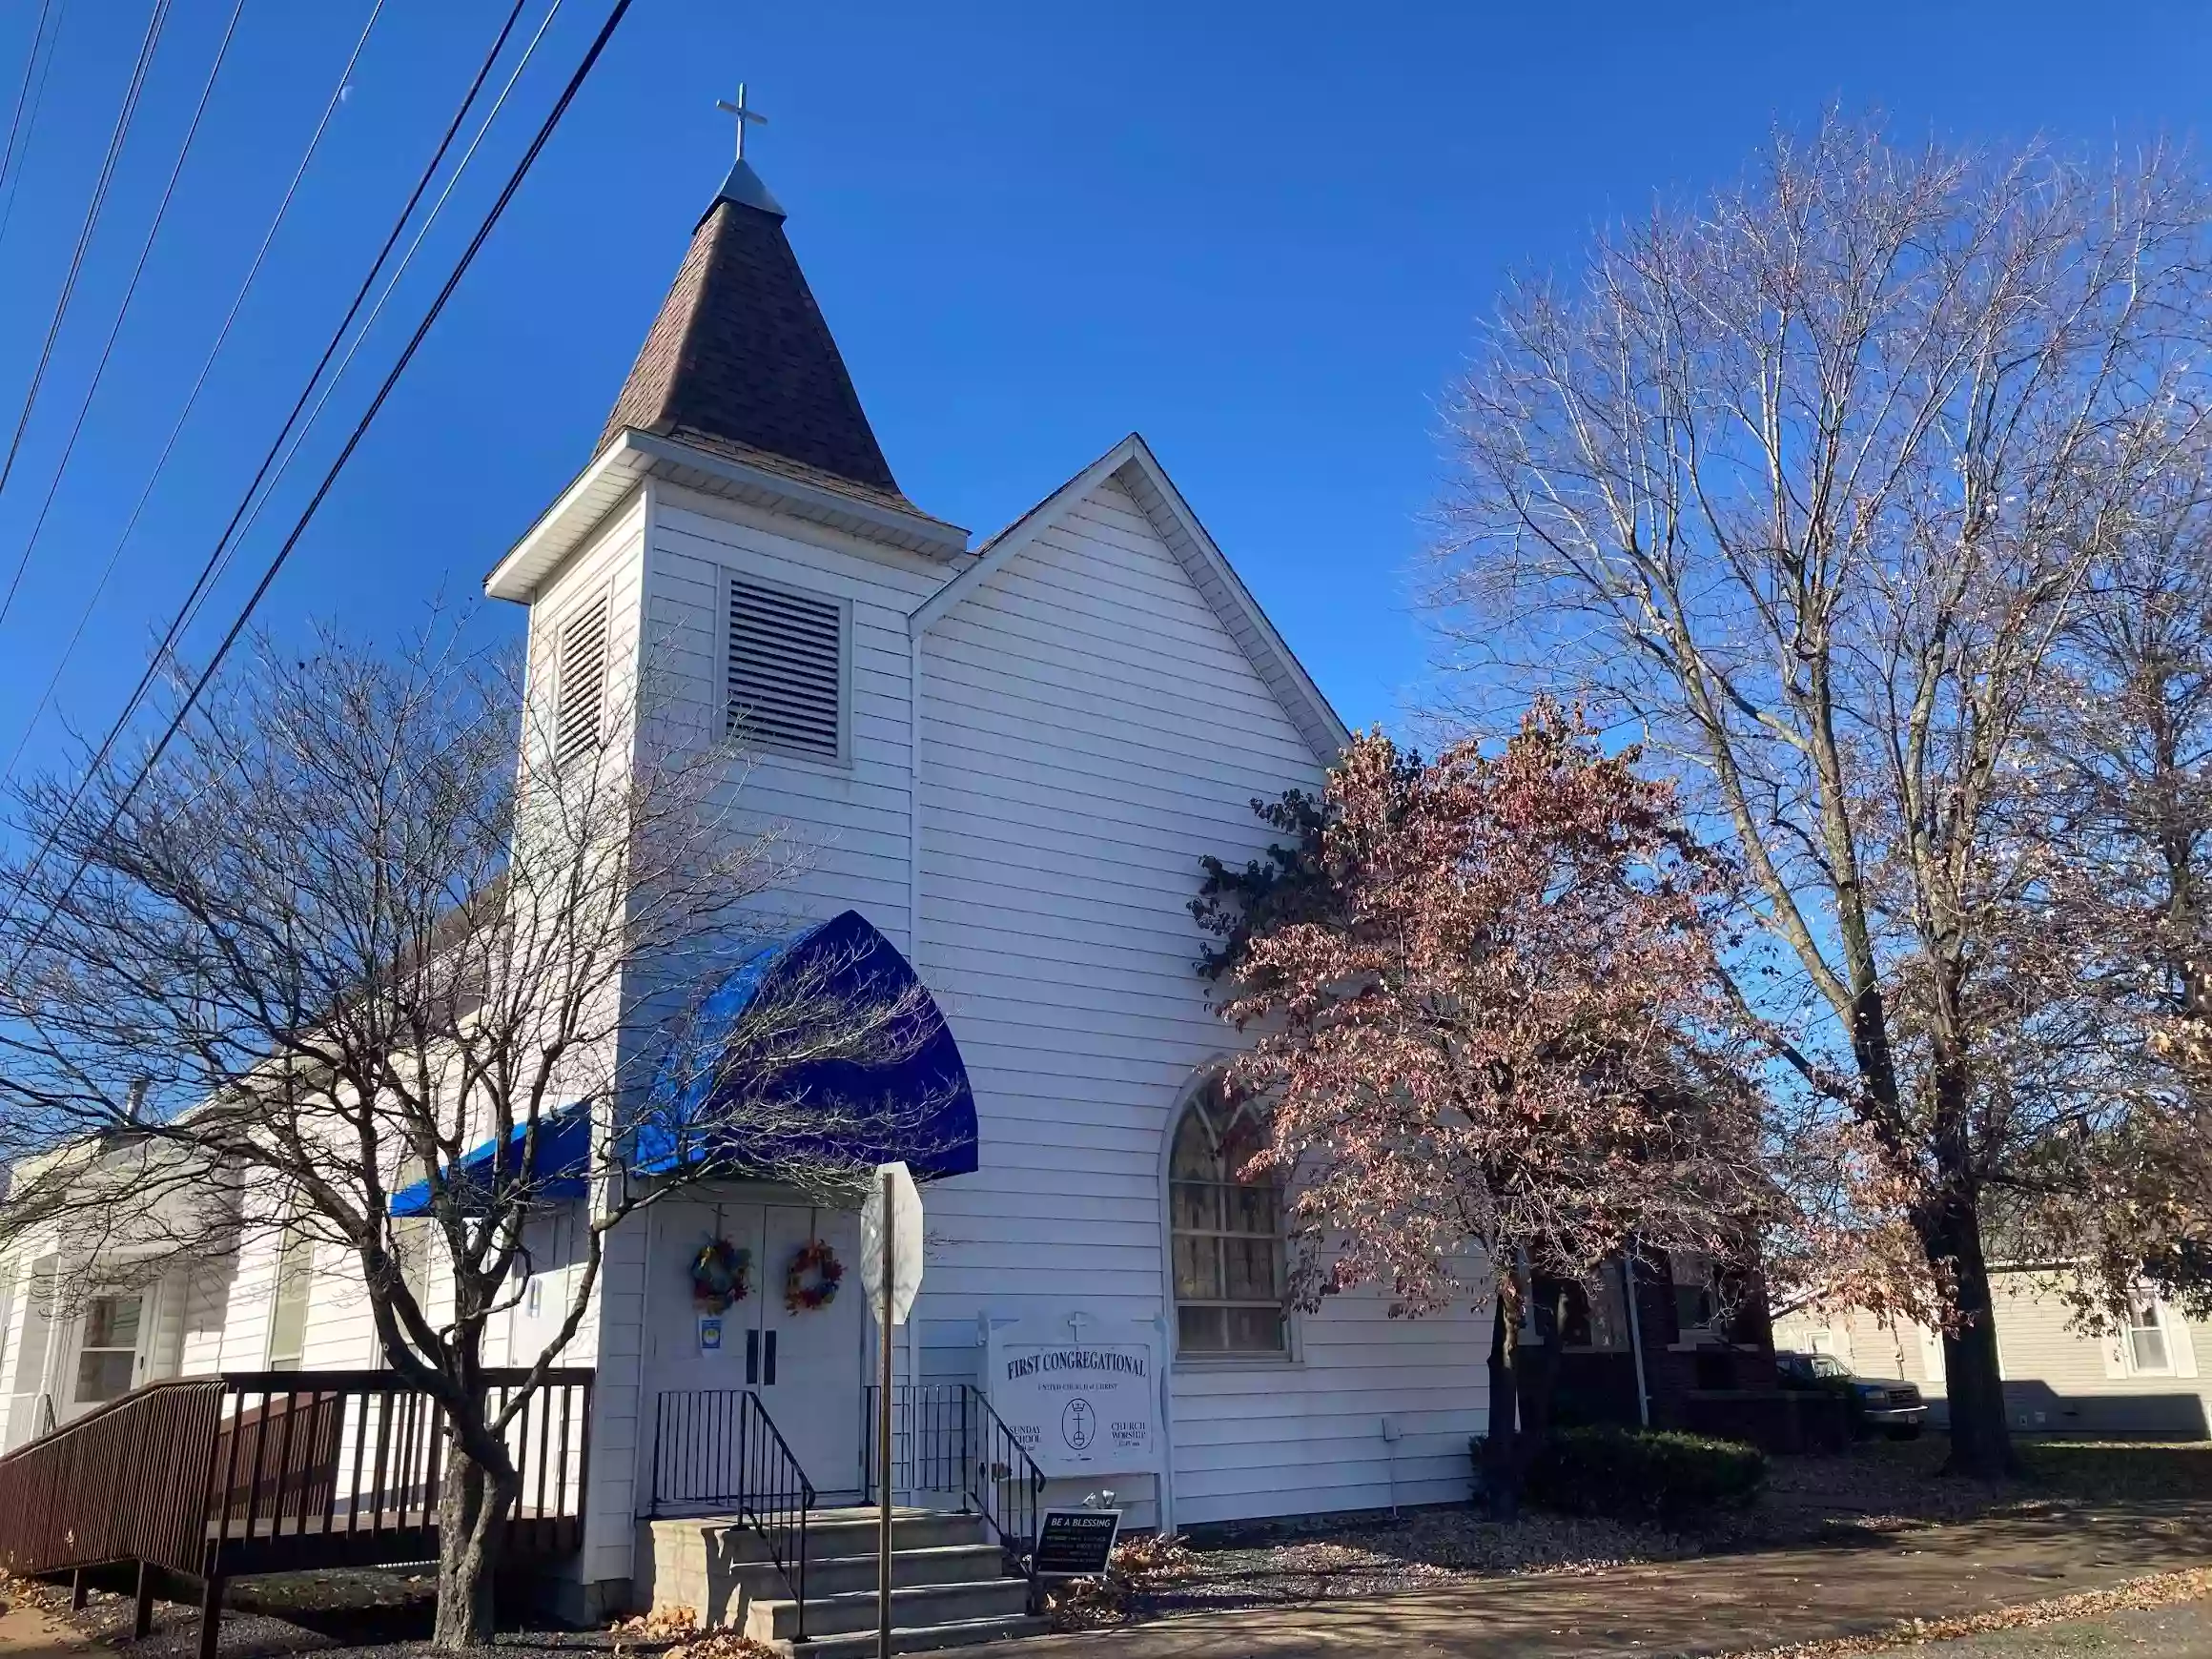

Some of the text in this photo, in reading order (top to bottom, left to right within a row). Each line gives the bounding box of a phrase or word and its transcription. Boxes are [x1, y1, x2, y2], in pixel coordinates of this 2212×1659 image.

[1007, 1350, 1146, 1381] FIRST CONGREGATIONAL
[1111, 1422, 1145, 1430] CHURCH
[1112, 1430, 1146, 1439] WORSHIP
[1051, 1518, 1111, 1527] BE A BLESSING
